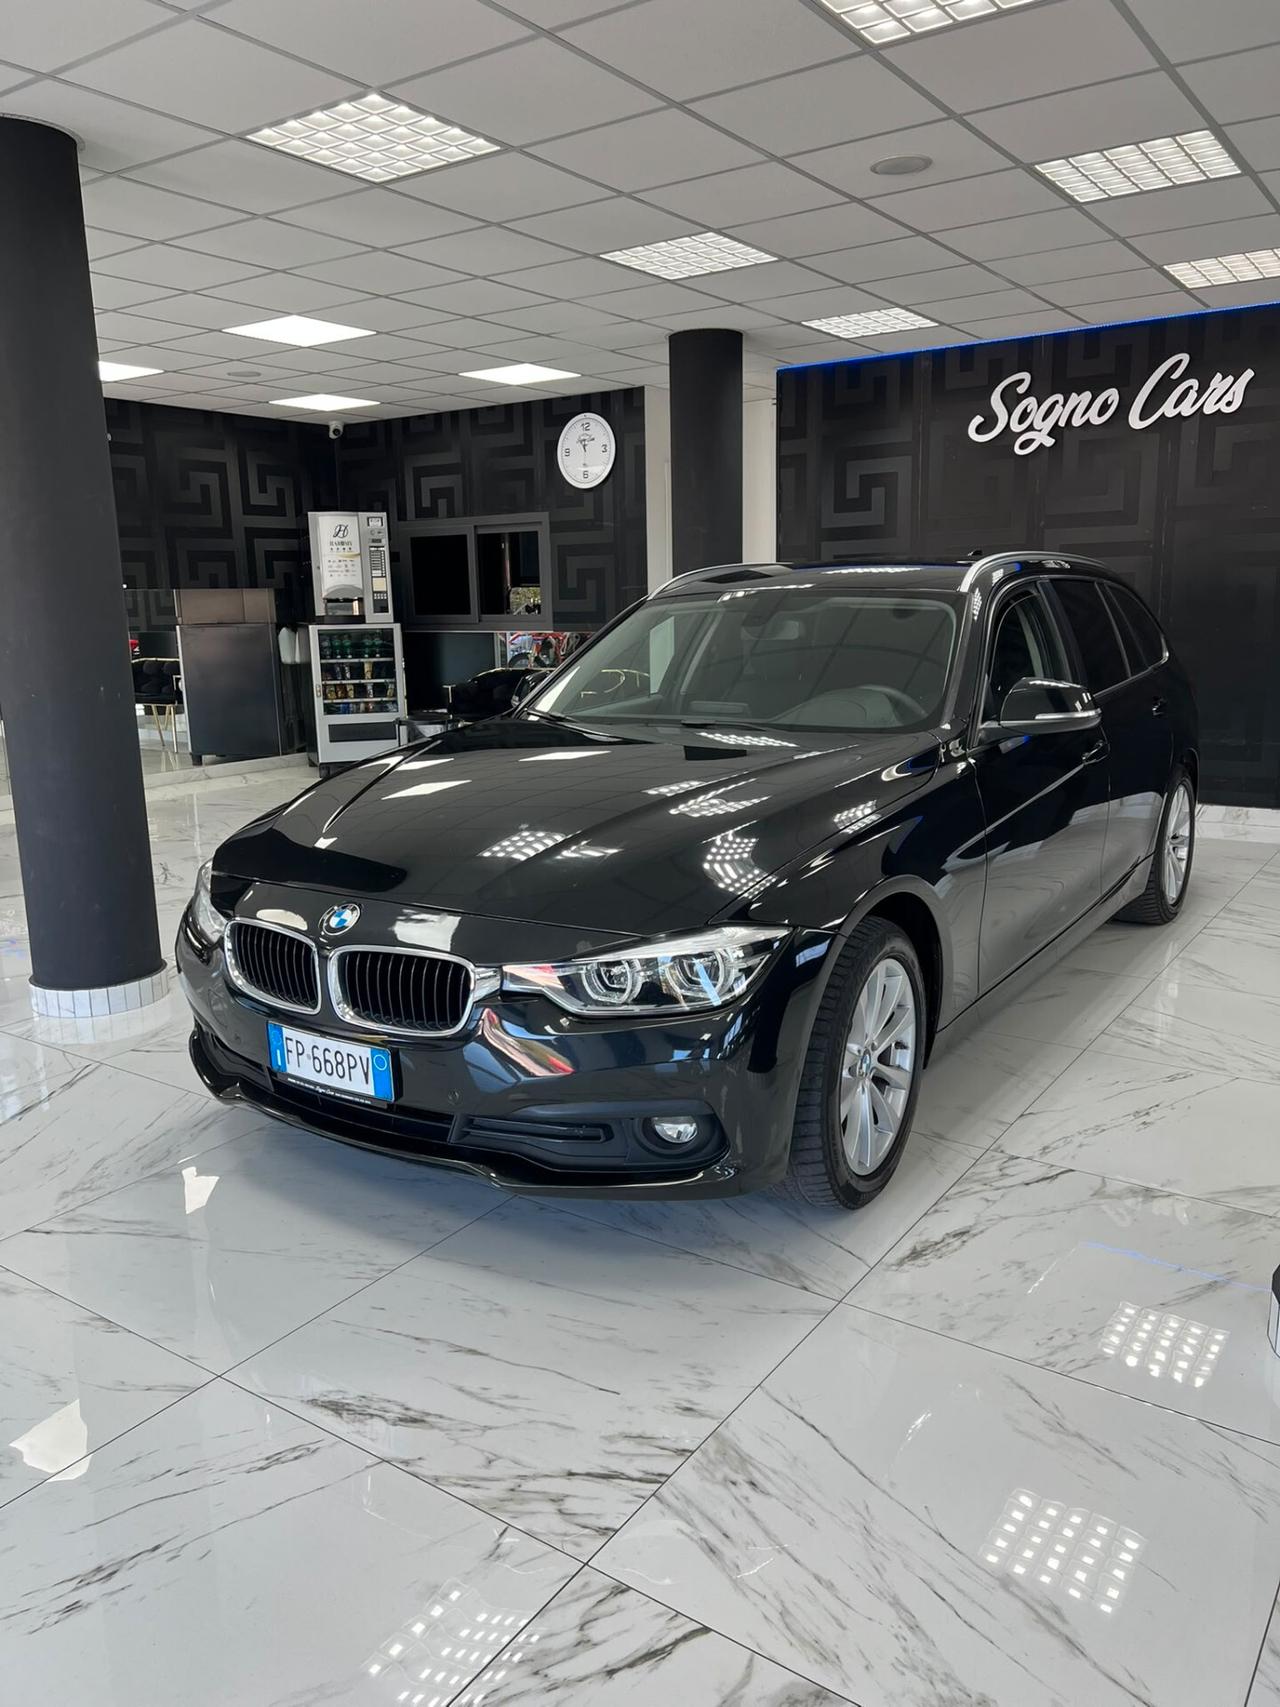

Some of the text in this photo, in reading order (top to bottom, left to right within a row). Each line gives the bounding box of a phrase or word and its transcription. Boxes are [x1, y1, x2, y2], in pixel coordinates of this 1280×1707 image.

[967, 352, 1256, 456] Sogno Cars
[581, 422, 591, 431] 12
[564, 448, 571, 457] 9
[601, 444, 608, 453] 3
[582, 470, 589, 479] 6
